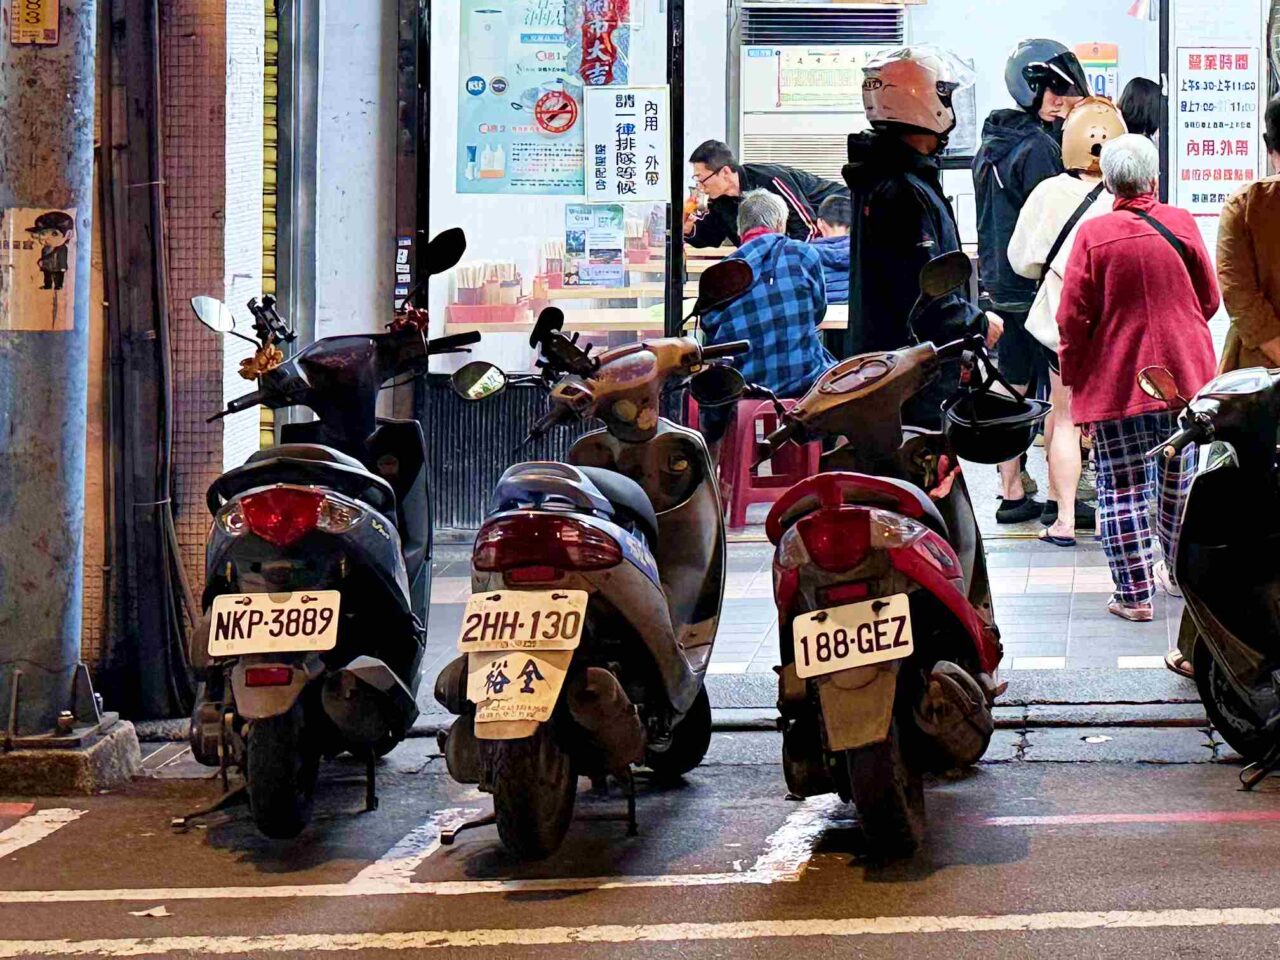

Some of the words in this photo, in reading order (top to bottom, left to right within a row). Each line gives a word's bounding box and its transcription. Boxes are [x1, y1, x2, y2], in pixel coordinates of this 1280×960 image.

[214, 607, 333, 642] NKP-3889
[461, 610, 582, 643] 2HH-130
[800, 615, 910, 666] 188-GEZ
